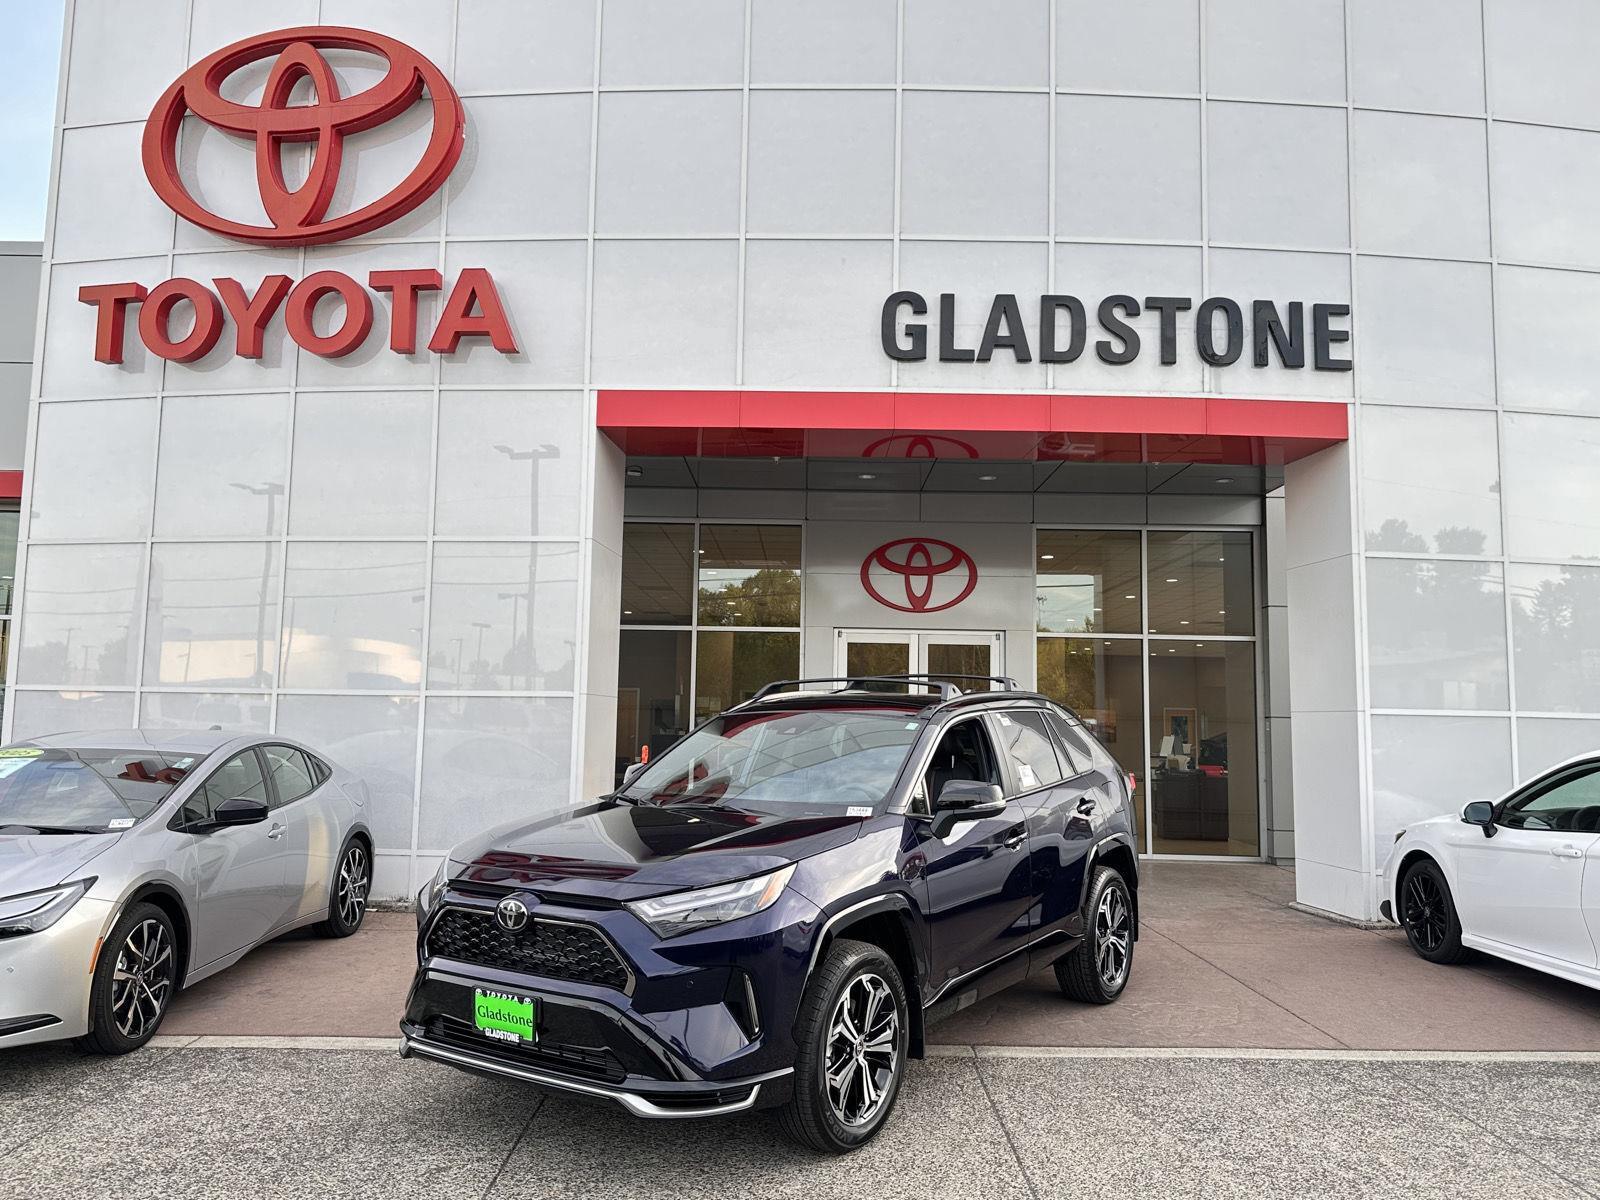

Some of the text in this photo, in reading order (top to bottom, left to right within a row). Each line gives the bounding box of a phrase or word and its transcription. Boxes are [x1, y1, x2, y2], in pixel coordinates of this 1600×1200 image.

[79, 267, 520, 364] TOYOTA
[881, 291, 1353, 371] GLADSTONE
[485, 990, 519, 1003] TOYOTA
[477, 1005, 534, 1028] Gladstone
[484, 1027, 520, 1043] GLADSTONE
